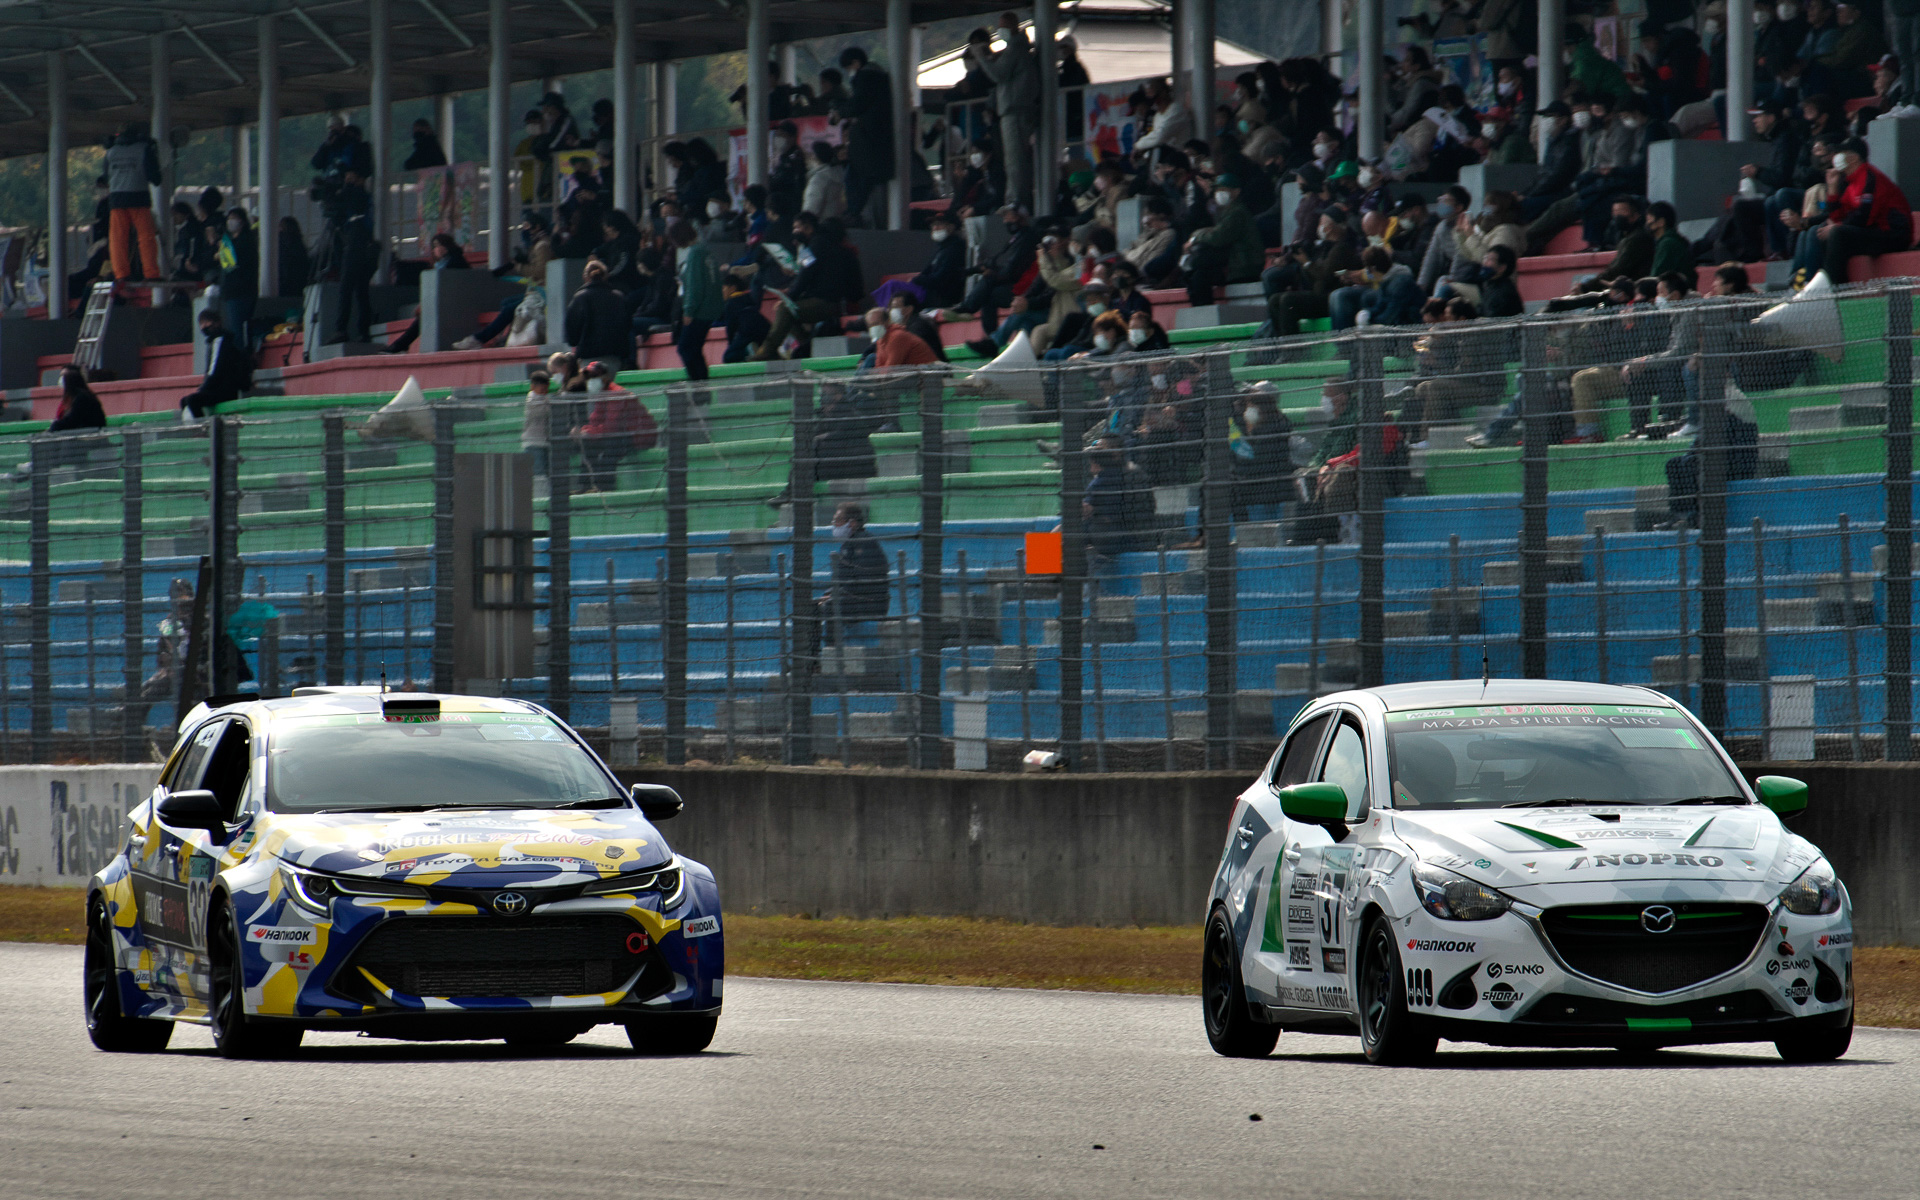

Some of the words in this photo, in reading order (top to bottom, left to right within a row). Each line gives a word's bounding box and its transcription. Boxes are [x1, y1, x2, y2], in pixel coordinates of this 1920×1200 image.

[1422, 718, 1500, 730] MAZDA
[1510, 716, 1571, 725] SPIRIT
[1583, 716, 1661, 726] RACING
[507, 723, 563, 742] 32
[379, 832, 481, 852] ROOKIE
[487, 831, 602, 846] RACING
[423, 856, 489, 866] TOYOTA
[559, 857, 614, 870] Racing
[1595, 852, 1724, 868] NOPRO
[1288, 907, 1315, 919] DIXCEL
[1504, 963, 1545, 976] SANKO
[1781, 959, 1811, 971] SANKO
[1482, 991, 1524, 1002] SHORAI
[1784, 986, 1813, 998] SHORAI
